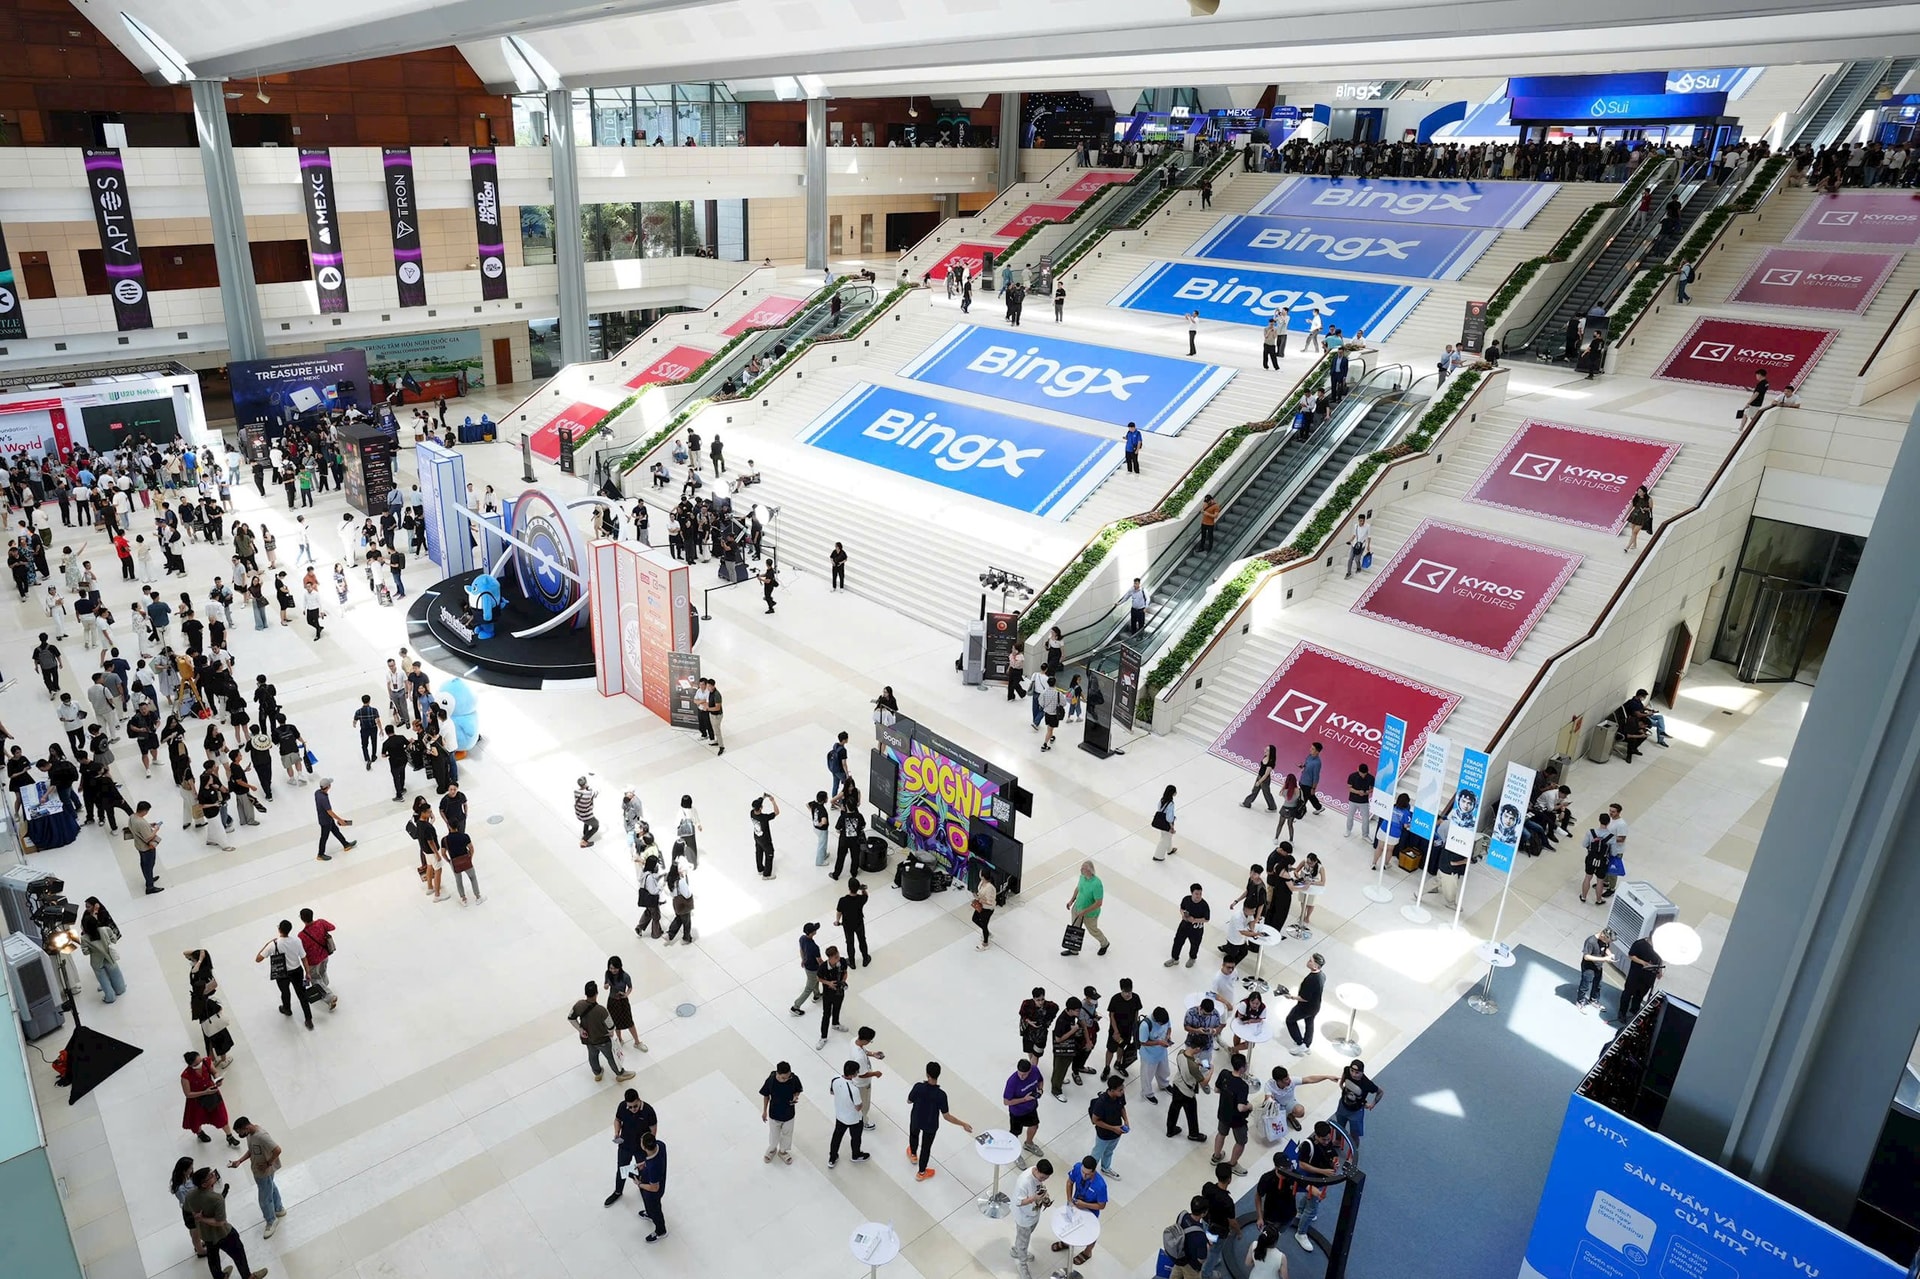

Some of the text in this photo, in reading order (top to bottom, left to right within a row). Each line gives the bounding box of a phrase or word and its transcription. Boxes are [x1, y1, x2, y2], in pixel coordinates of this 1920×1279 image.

[1695, 75, 1720, 88] Sui
[1226, 108, 1253, 116] MEXC
[1608, 101, 1630, 113] Sui
[311, 173, 329, 224] MEXC
[394, 174, 409, 216] TRON
[478, 192, 488, 222] HOLD
[484, 181, 498, 226] STATION
[1807, 273, 1862, 282] KYROS
[1802, 279, 1858, 289] VENTURES
[1738, 348, 1795, 362] KYROS
[1733, 356, 1790, 368] VENTURES
[255, 363, 344, 380] TREASURE HUNT
[651, 362, 690, 379] SSID
[4, 435, 42, 452] World
[1563, 465, 1629, 485] KYROS
[1558, 474, 1620, 493] VENTURES
[1458, 575, 1526, 601] KYROS
[1451, 586, 1516, 610] VENTURES
[1326, 712, 1384, 746] KYRO
[1386, 730, 1400, 739] DIGITAL
[1387, 725, 1401, 734] TRADE
[883, 731, 901, 747] Sogni
[1385, 735, 1400, 745] ASSETS
[1386, 740, 1397, 748] ONLY
[1427, 748, 1444, 758] DIGITAL
[1430, 743, 1444, 752] TRADE
[1427, 754, 1443, 763] ASSETS
[1428, 759, 1440, 767] ONLY
[1467, 759, 1483, 768] TRADE
[1464, 764, 1483, 774] DIGITAL
[1464, 769, 1482, 779] ASSETS
[1465, 775, 1479, 783] ONLY
[1508, 778, 1527, 789] DIGITAL
[1510, 774, 1528, 783] TRADE
[903, 756, 982, 819] SOGNI
[1470, 782, 1481, 790] HTX
[1507, 784, 1526, 794] ASSETS
[1509, 790, 1522, 798] ONLY
[1597, 1124, 1629, 1147] HTX
[1601, 1198, 1616, 1210] Giao
[1600, 1204, 1631, 1225] giao ngay
[1623, 1162, 1819, 1278] SẢN PHẨM VÀ DỊCH VỤ
[1598, 1209, 1644, 1240] (Spot Trading)
[1675, 1208, 1748, 1256] CỦA HTX
[1675, 1242, 1691, 1255] Giao
